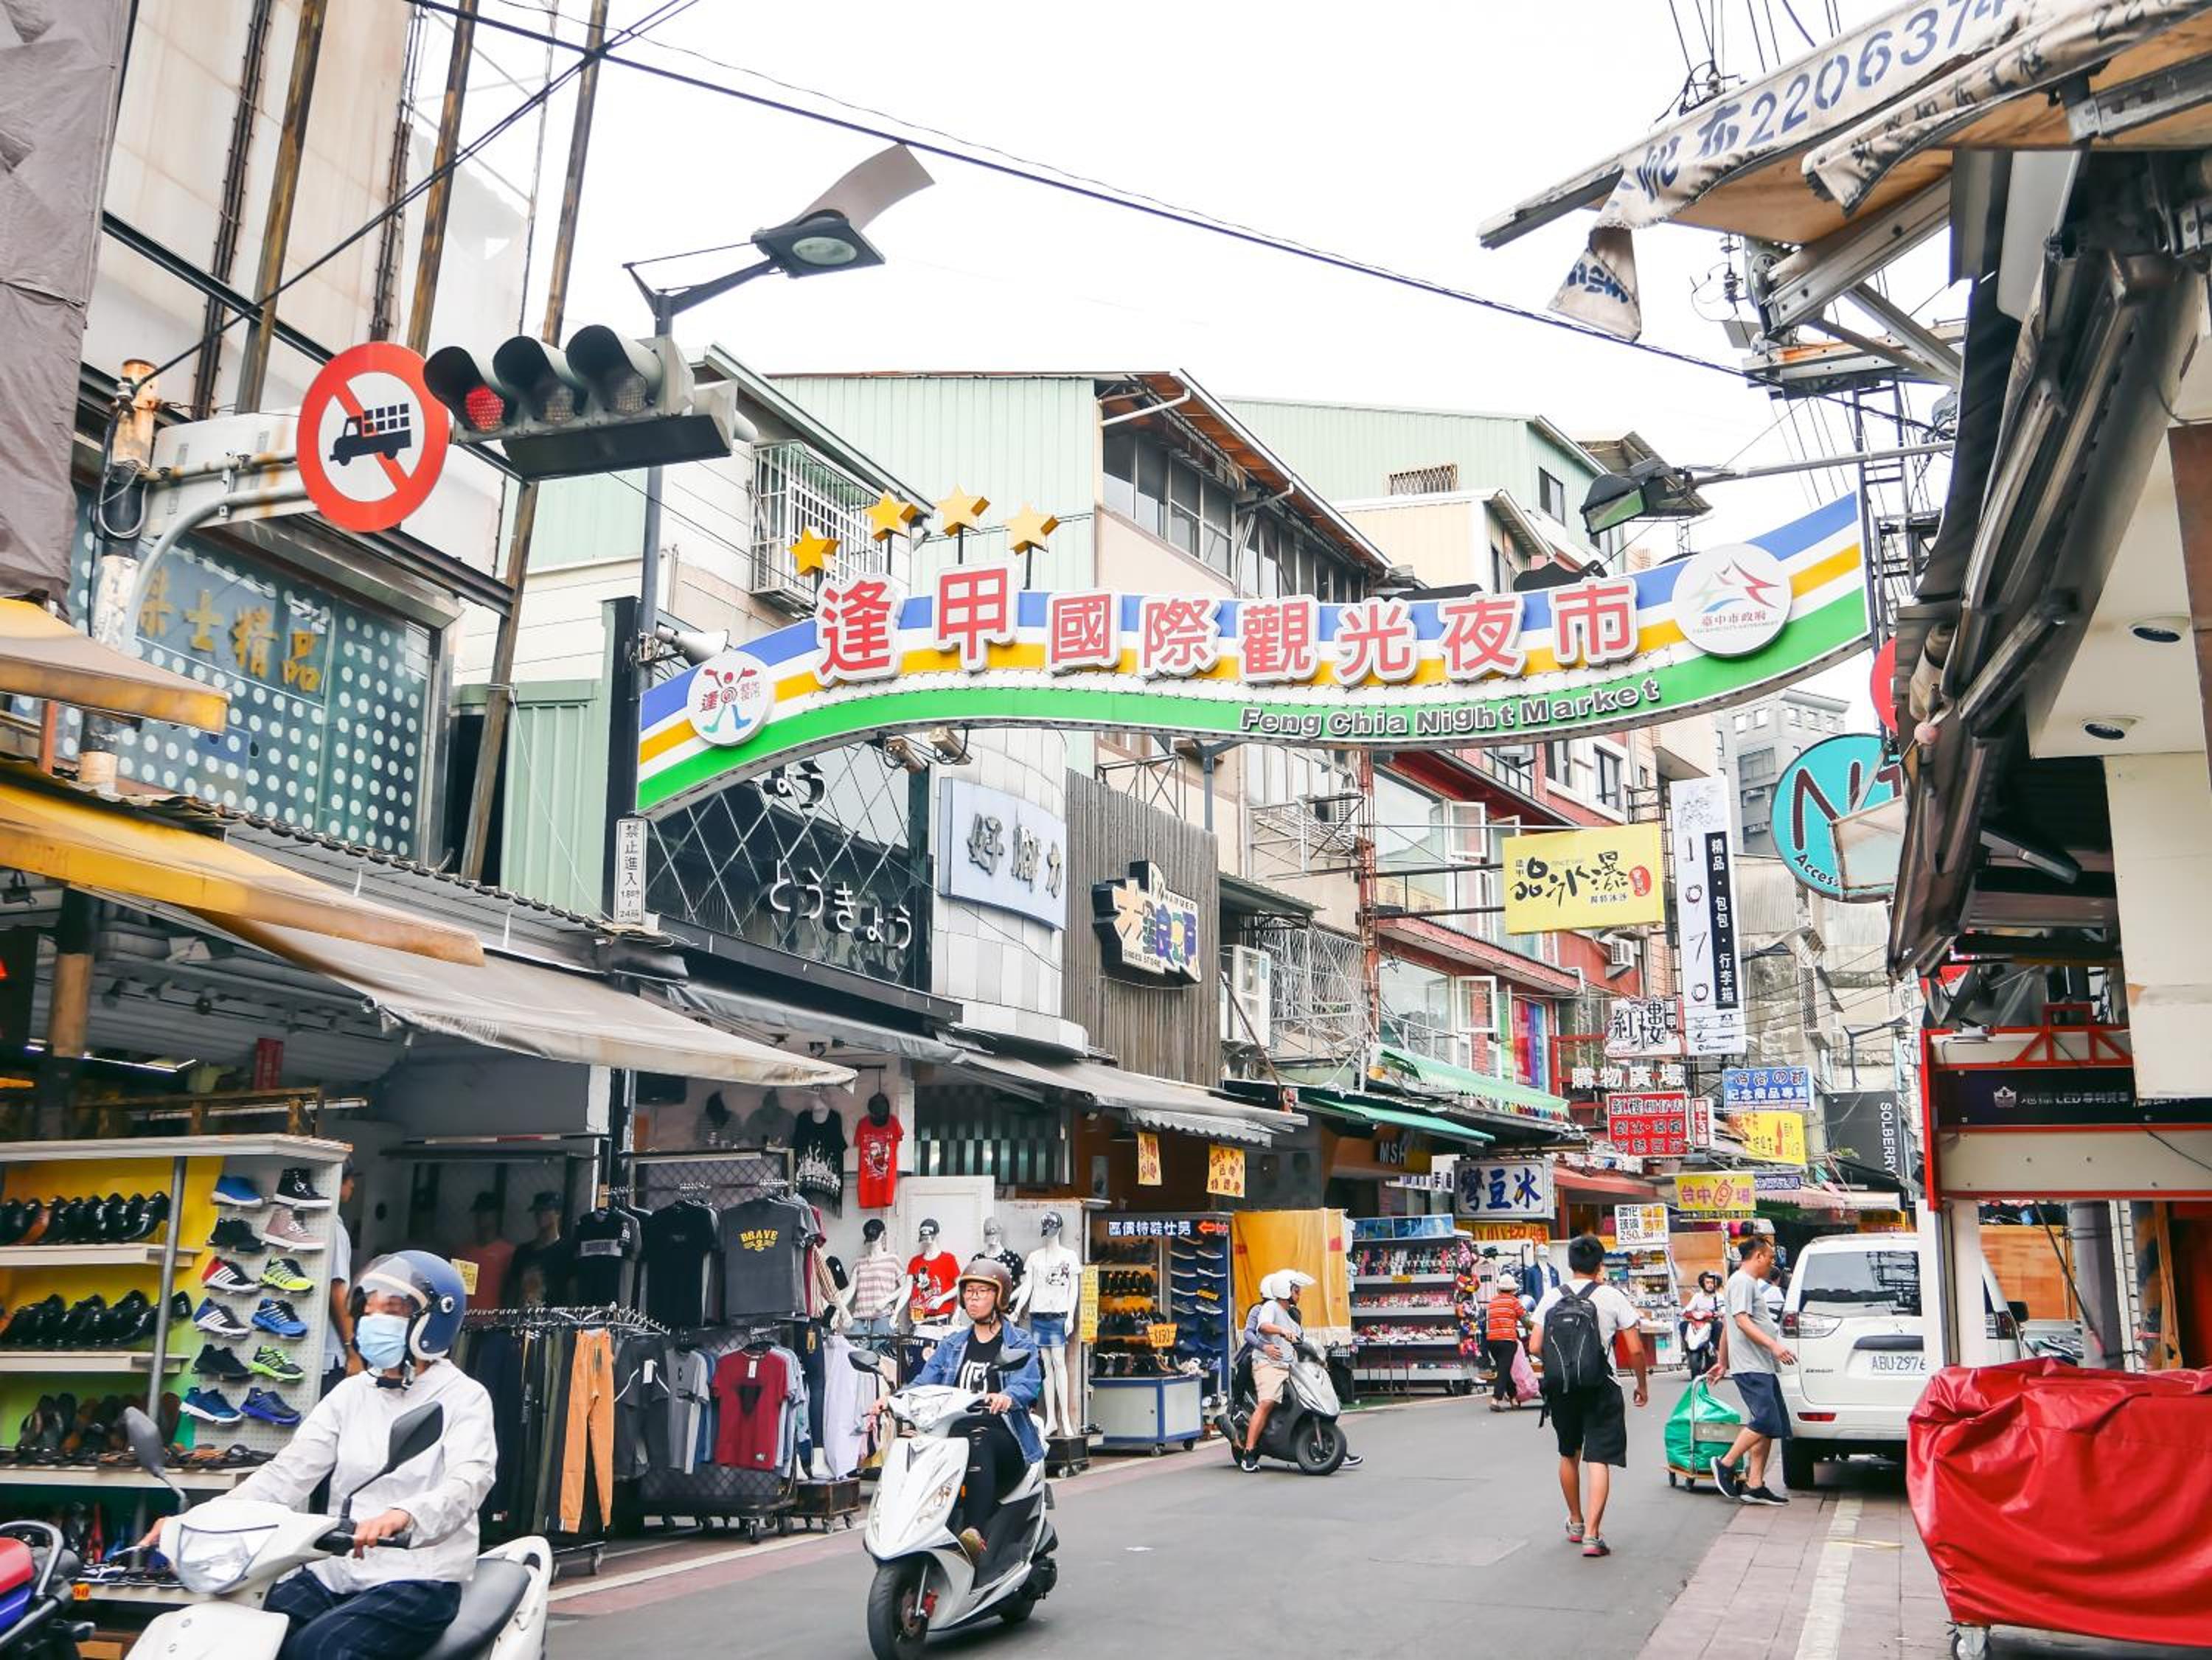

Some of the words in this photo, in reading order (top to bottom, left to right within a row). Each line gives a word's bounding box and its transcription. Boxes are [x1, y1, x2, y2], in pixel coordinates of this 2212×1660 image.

[815, 565, 1635, 683] 逢甲國際觀光夜市
[1242, 707, 1321, 736] Feng
[1327, 709, 1408, 735] Chia
[1415, 704, 1514, 735] Night
[1521, 677, 1660, 723] Market
[625, 824, 639, 885] 禁止進入
[769, 859, 912, 950] とうきょう
[1572, 1064, 1686, 1089] 購物廣場
[1879, 1102, 1898, 1175] SOLBERRY
